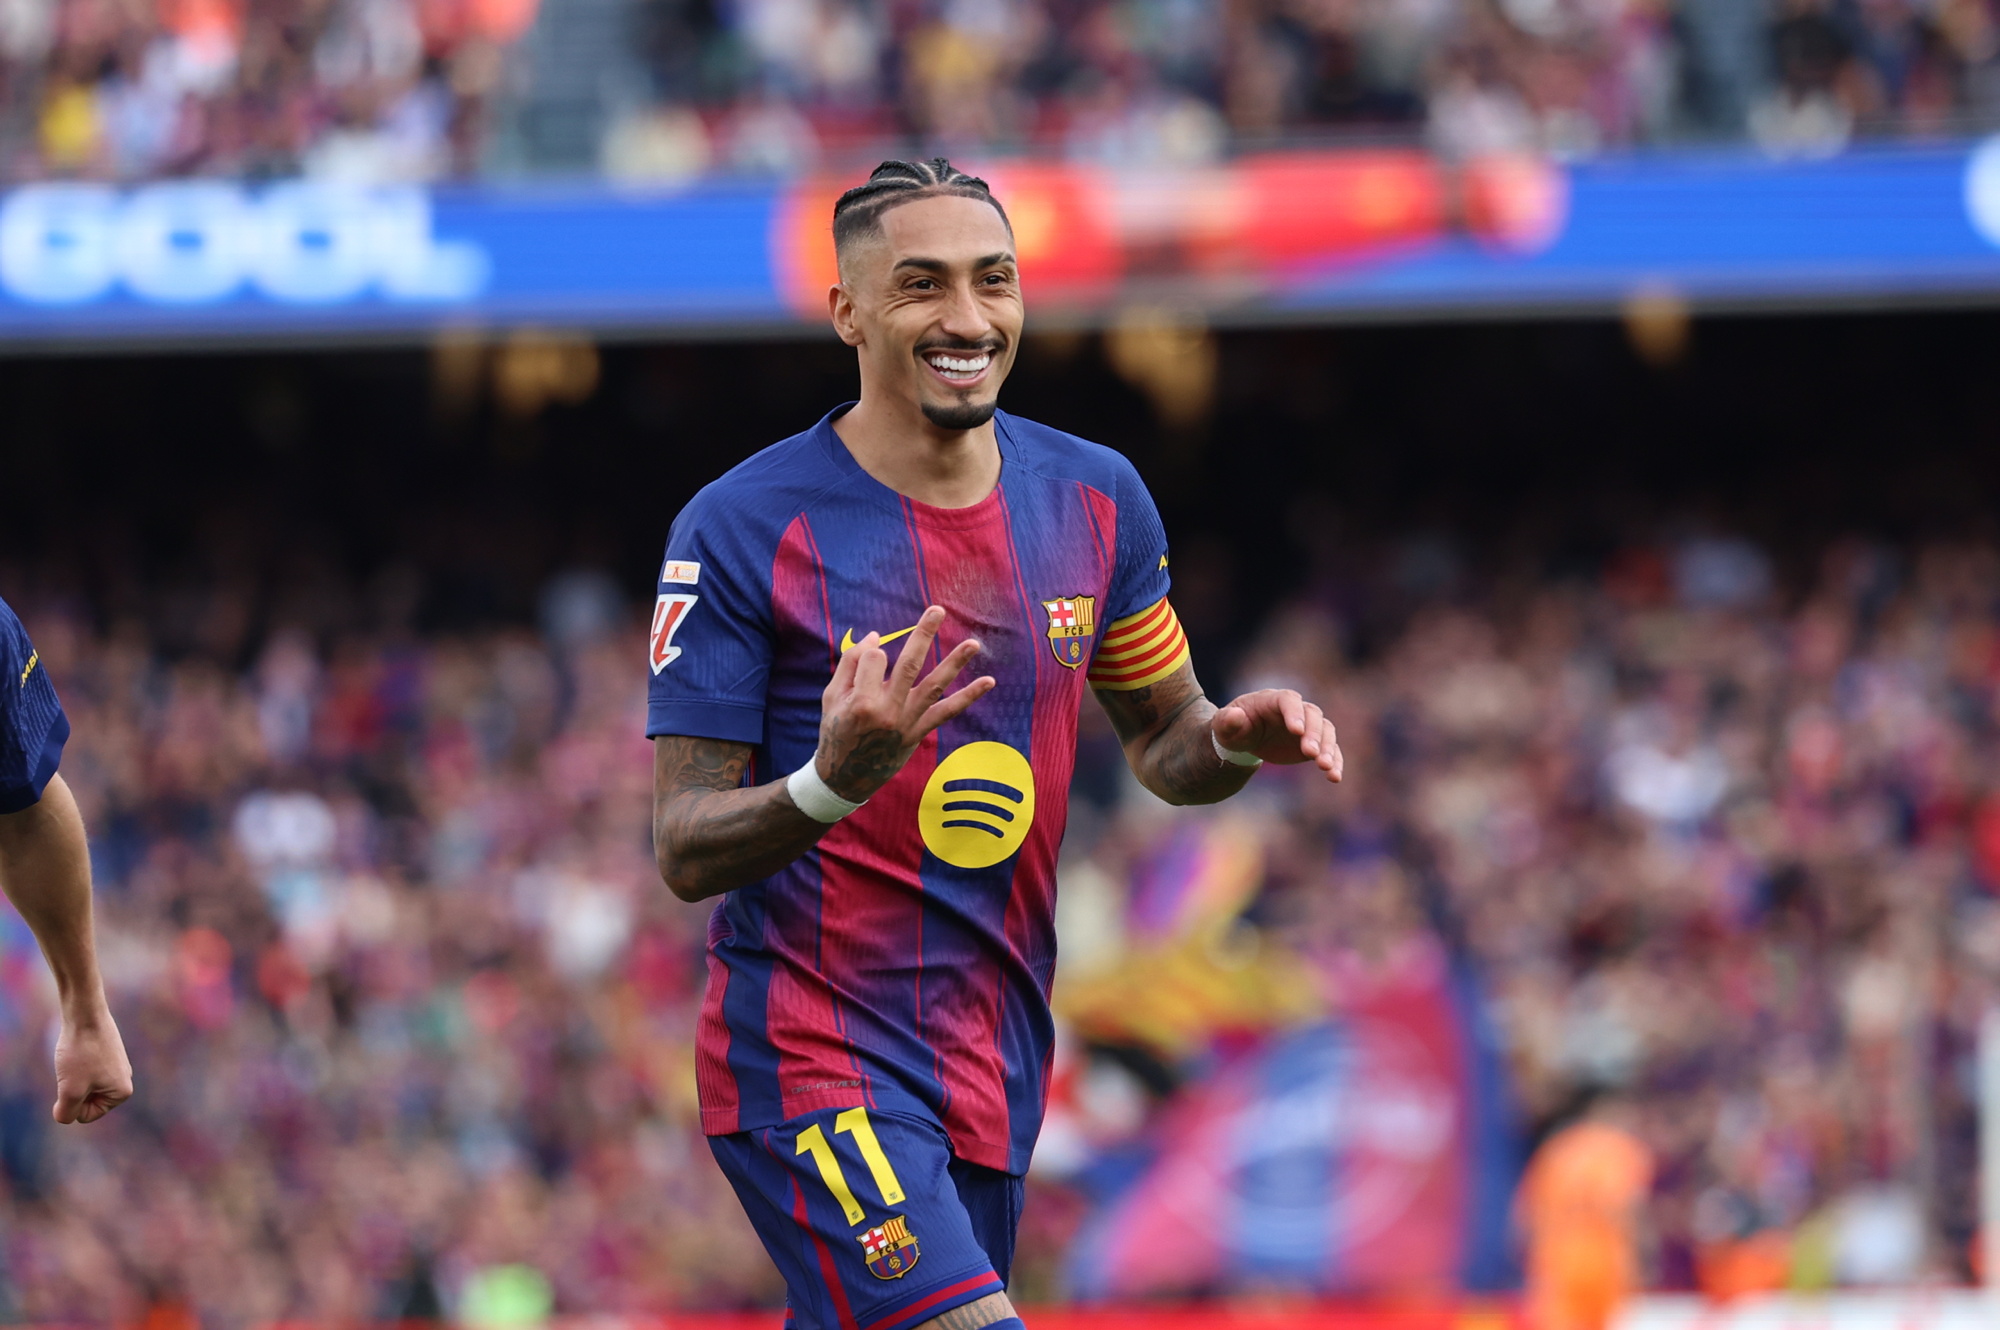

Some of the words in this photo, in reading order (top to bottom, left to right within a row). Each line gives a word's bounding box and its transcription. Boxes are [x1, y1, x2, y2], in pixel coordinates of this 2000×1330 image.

[1064, 626, 1084, 637] FCB
[795, 1106, 906, 1227] 11
[878, 1242, 900, 1258] FCB
